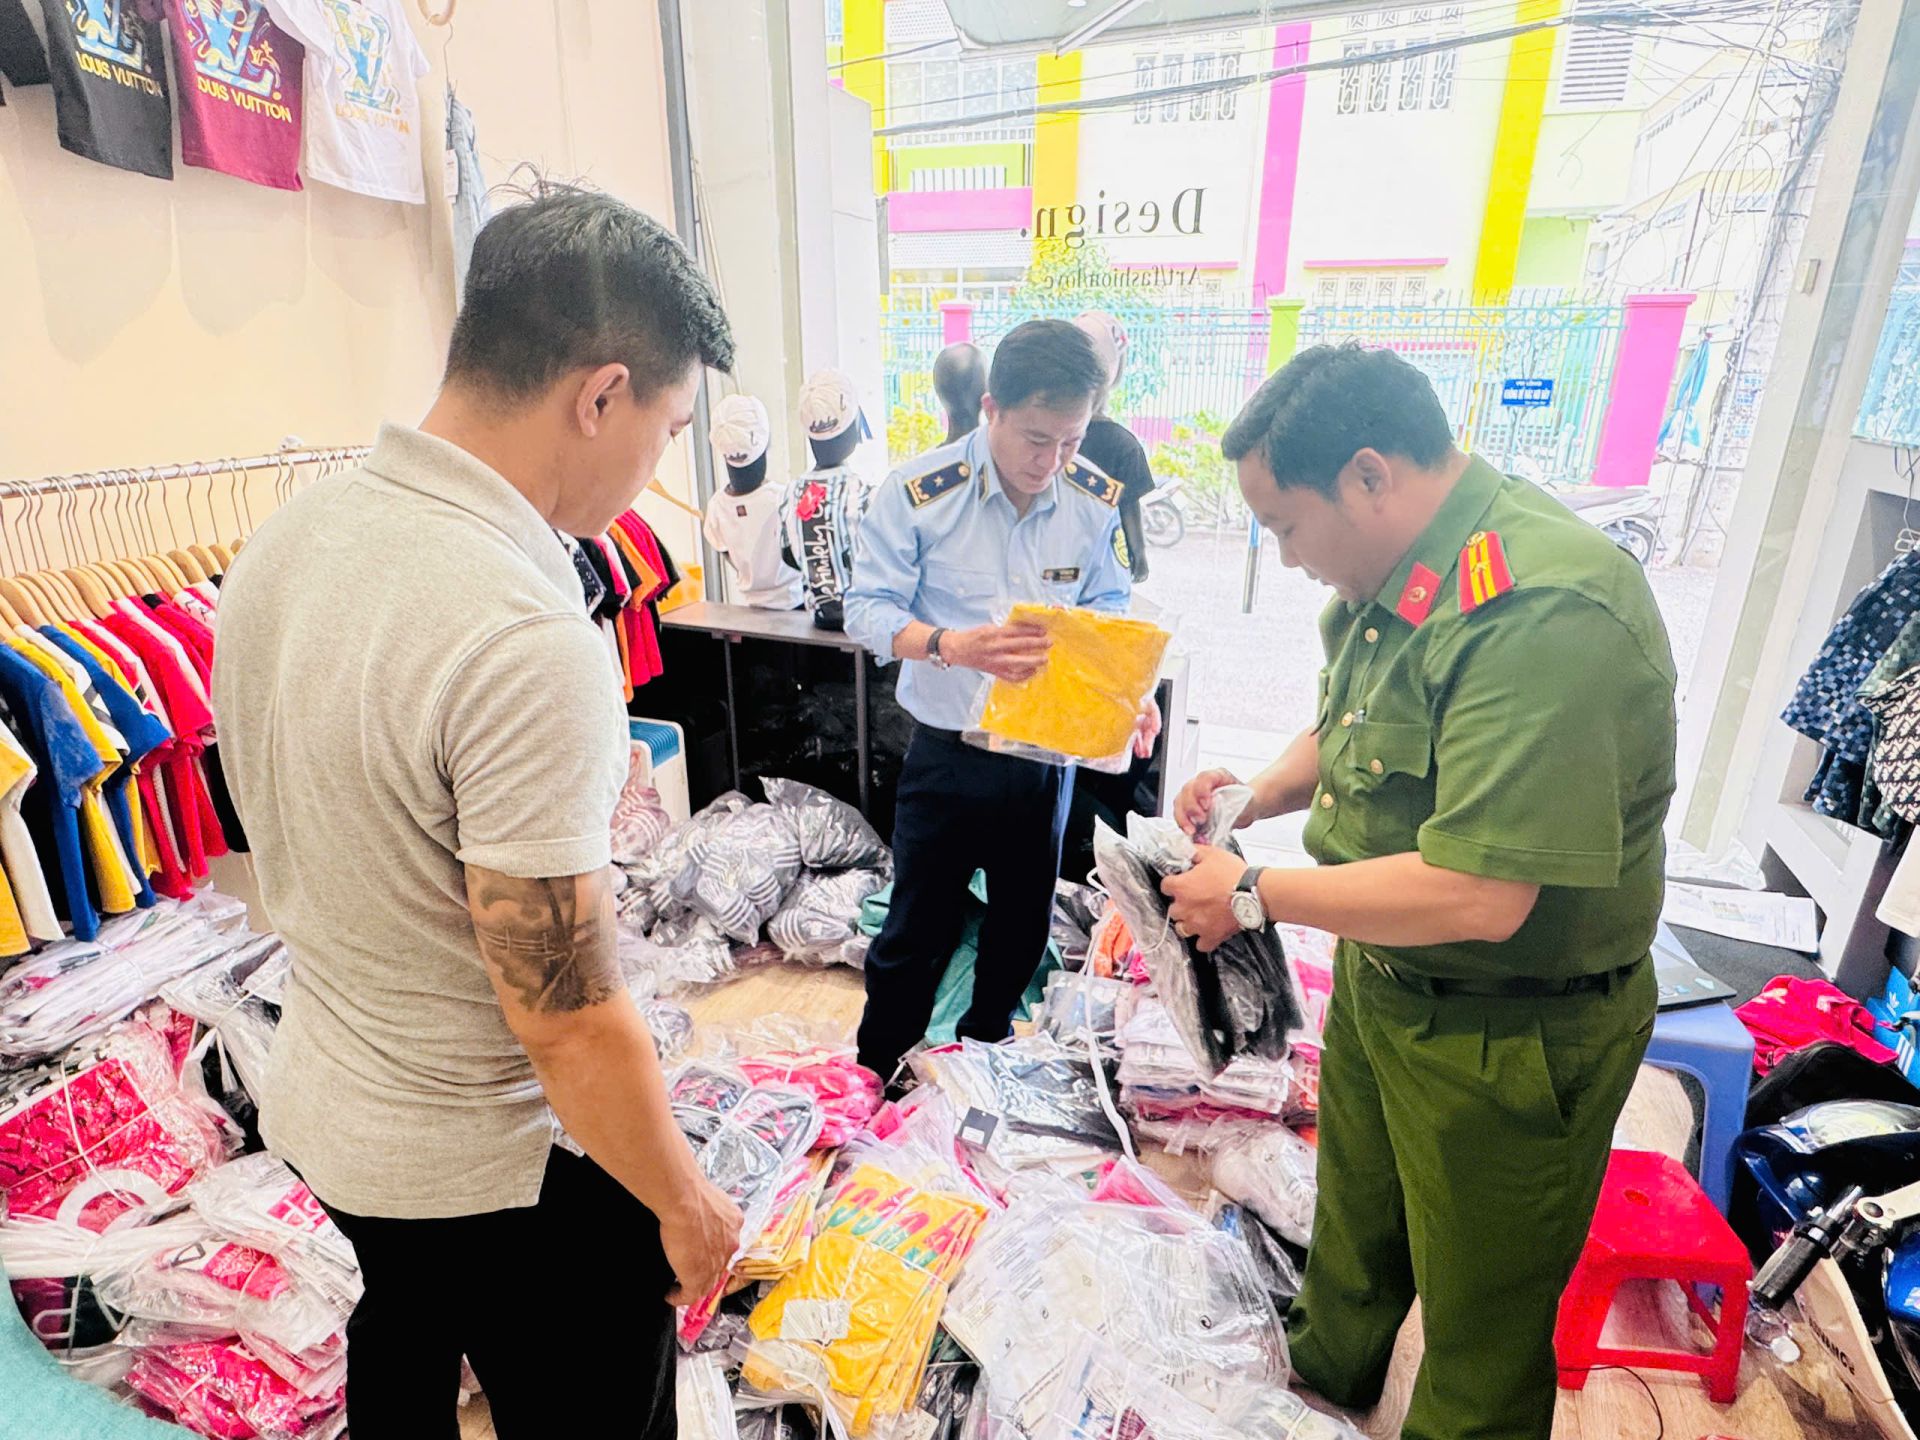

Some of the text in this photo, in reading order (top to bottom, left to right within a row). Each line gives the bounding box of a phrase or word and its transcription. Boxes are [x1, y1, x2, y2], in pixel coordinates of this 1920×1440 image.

[75, 51, 164, 98] LOUIS VUITTON
[230, 87, 292, 123] VUITTON
